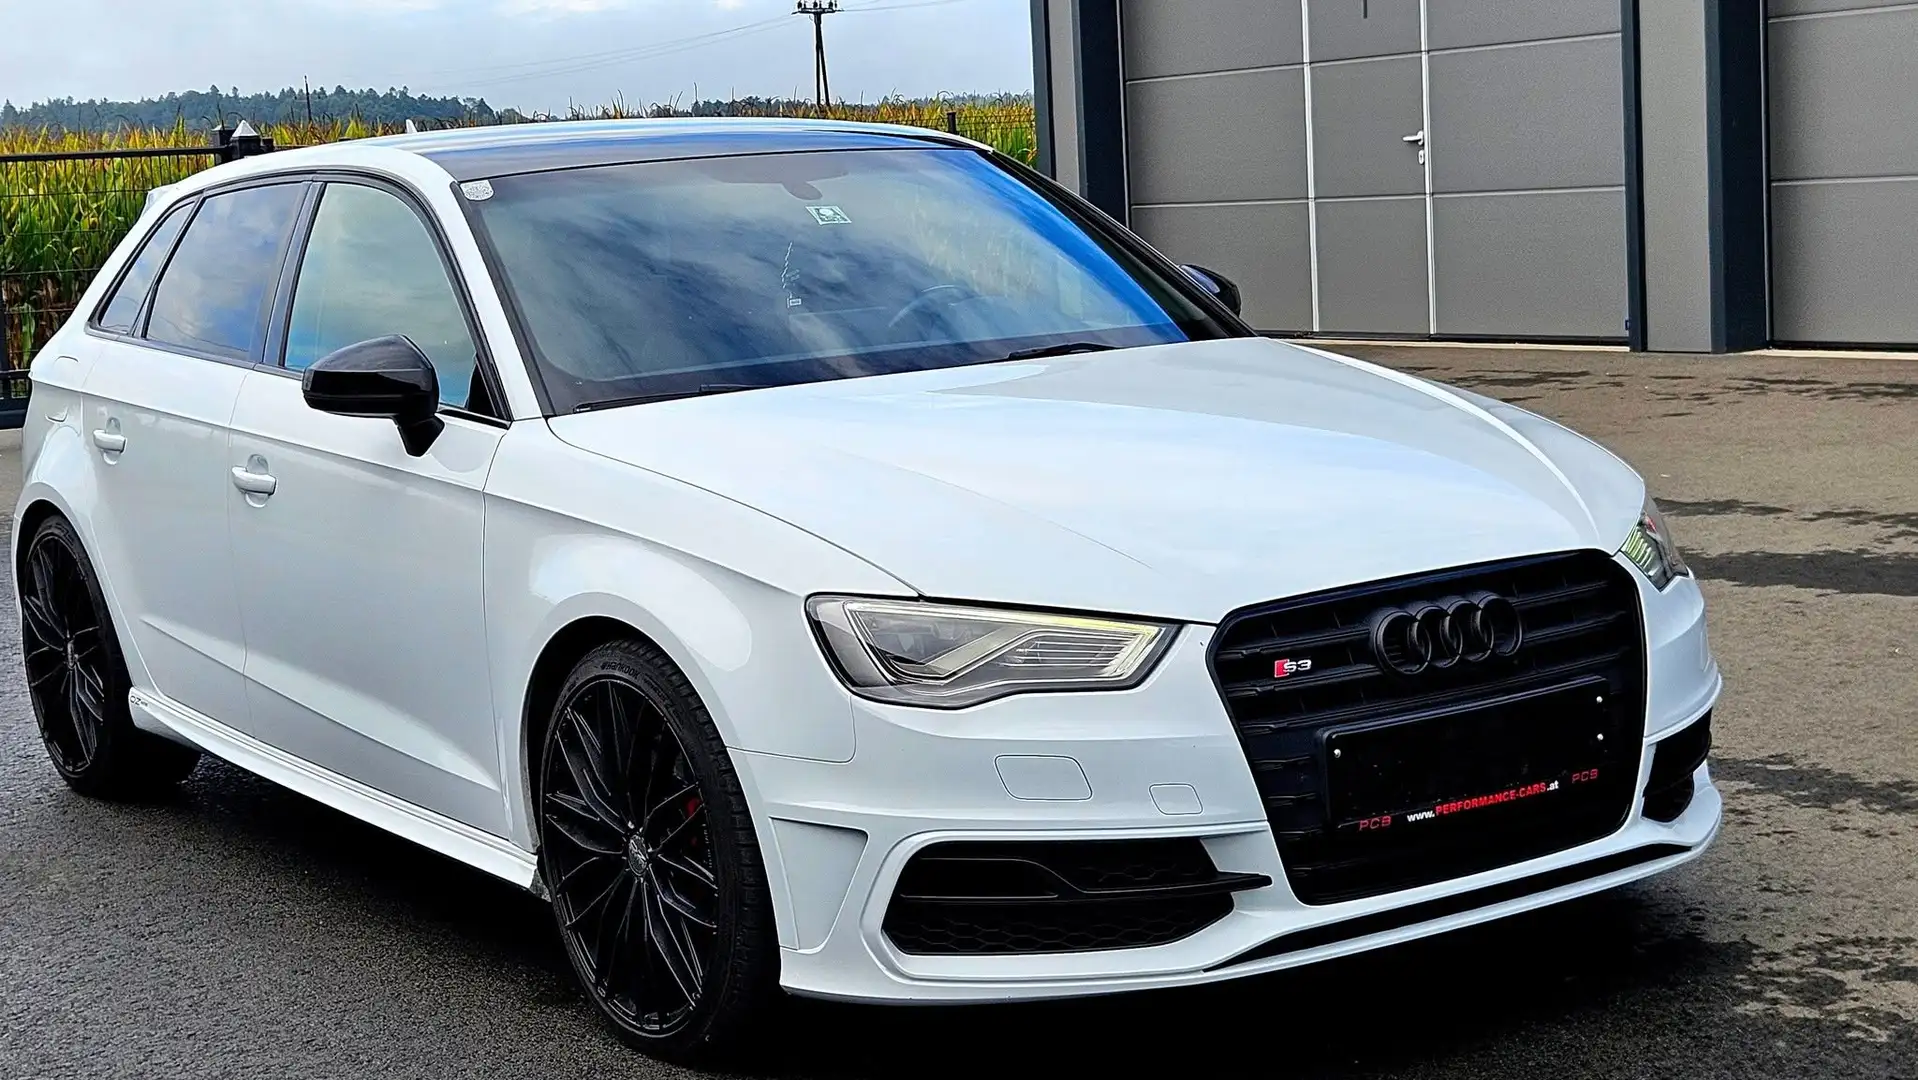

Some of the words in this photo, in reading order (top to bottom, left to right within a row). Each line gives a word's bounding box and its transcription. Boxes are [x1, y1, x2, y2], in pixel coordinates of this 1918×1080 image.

[1283, 659, 1312, 673] S3
[1358, 815, 1392, 832] PCB
[1406, 780, 1559, 823] www.PERFORMANCE-CARS.at
[1571, 768, 1599, 784] PCB
